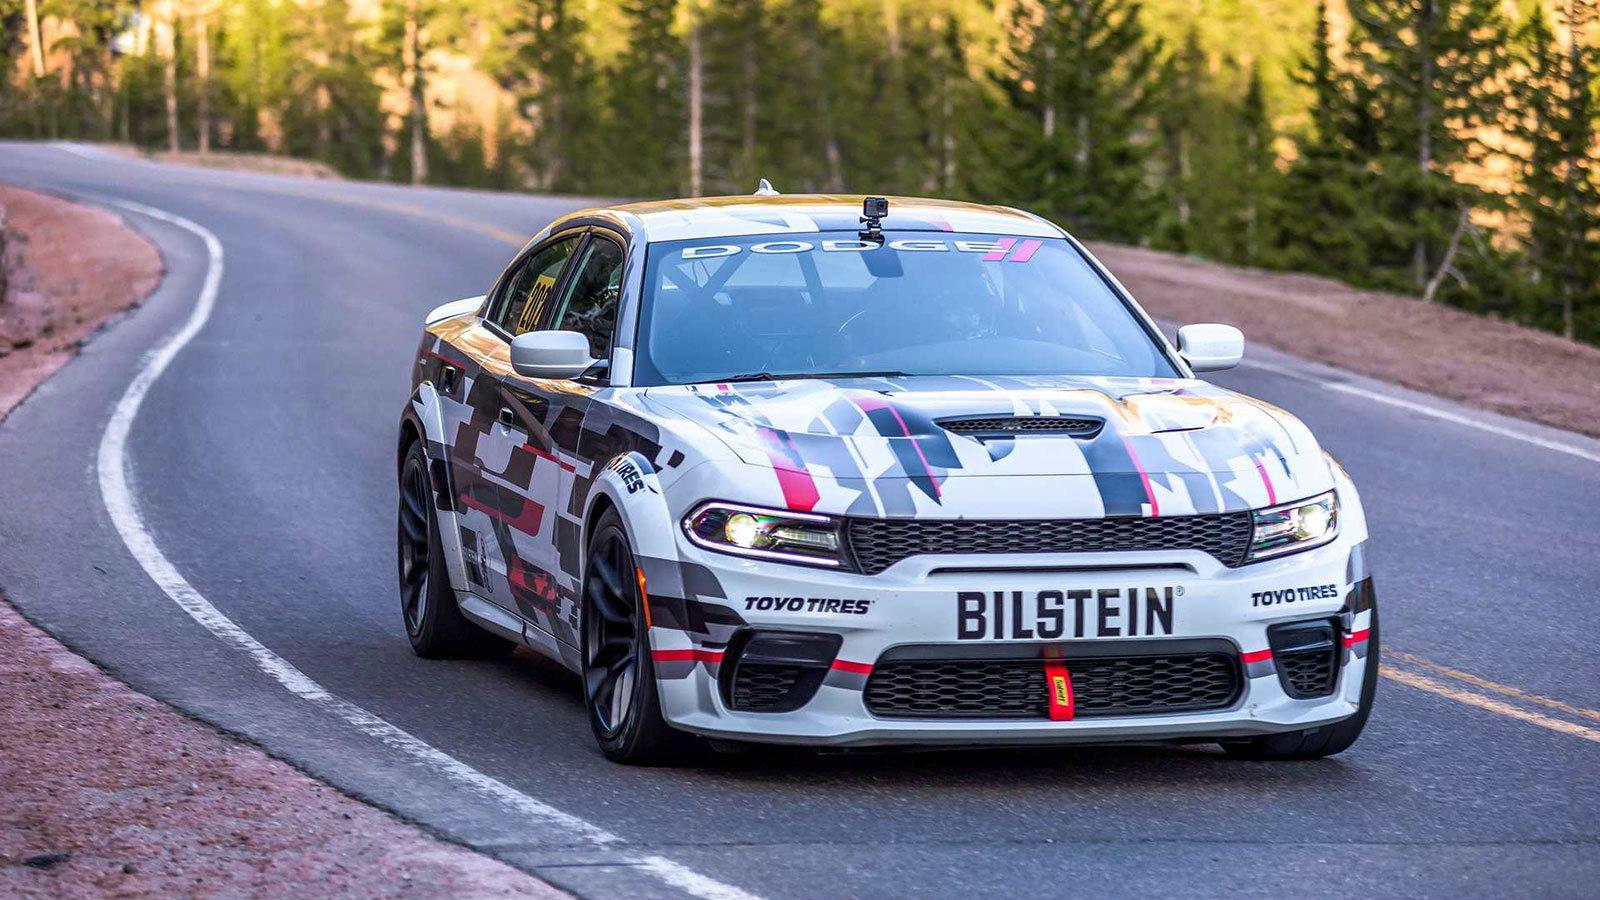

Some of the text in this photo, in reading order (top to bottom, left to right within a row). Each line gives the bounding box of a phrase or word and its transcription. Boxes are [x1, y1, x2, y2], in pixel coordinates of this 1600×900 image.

[681, 239, 1010, 260] DODGE
[744, 596, 870, 615] TOYO TIRES
[1251, 584, 1338, 607] TOYO TIRES
